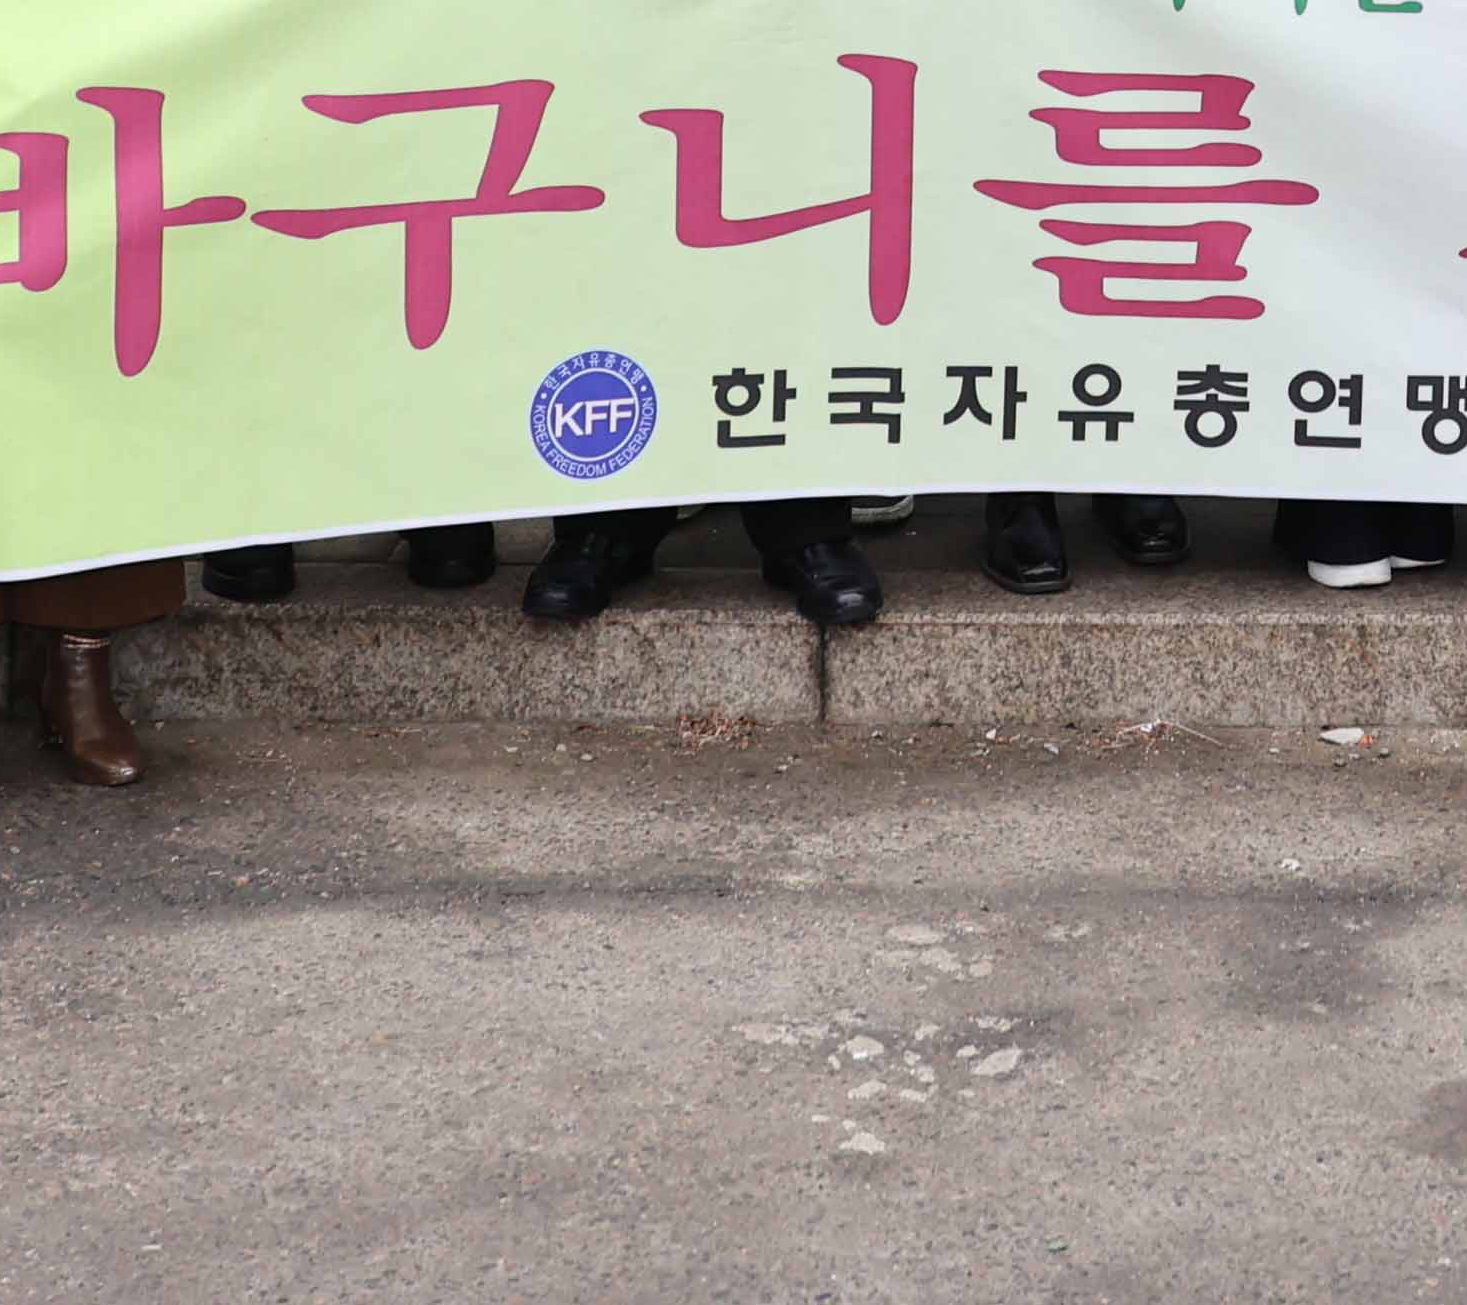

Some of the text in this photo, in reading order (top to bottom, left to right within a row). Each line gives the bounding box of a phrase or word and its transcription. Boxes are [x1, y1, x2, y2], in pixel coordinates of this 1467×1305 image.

[544, 352, 645, 391] 한국자유총연맹
[532, 395, 656, 478] KOREA FREEDOM FEDERATION
[553, 397, 635, 439] KFF
